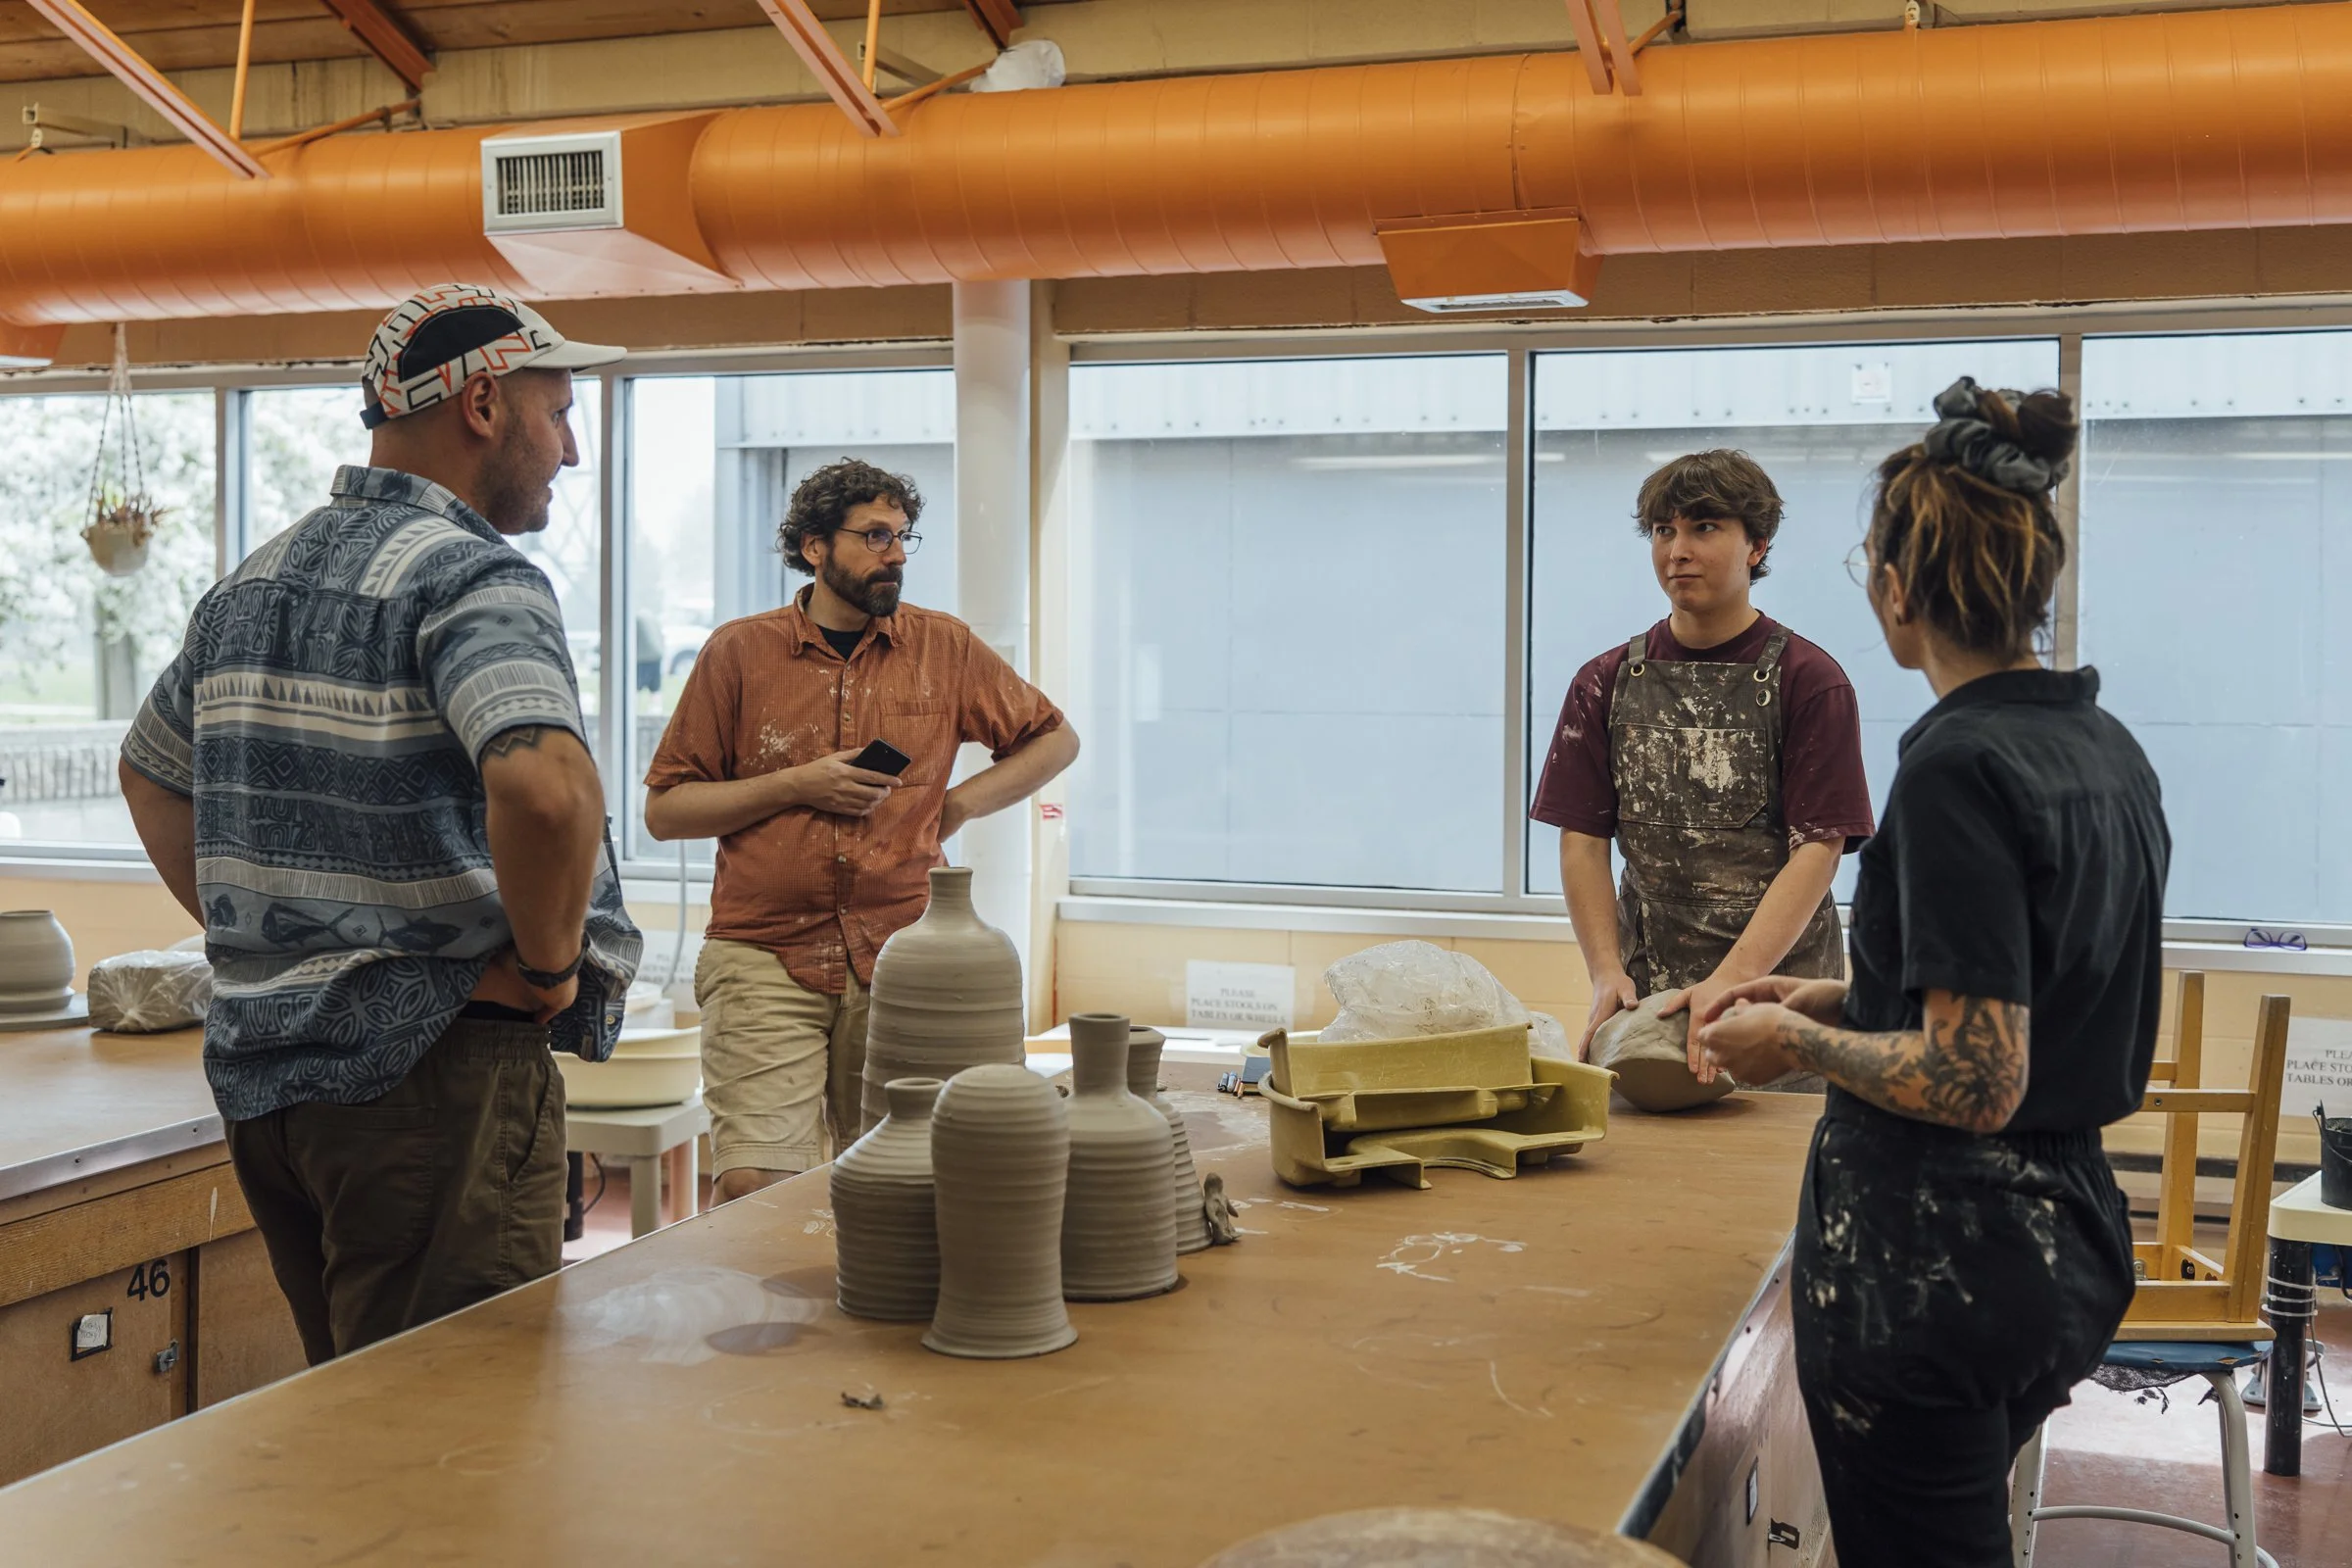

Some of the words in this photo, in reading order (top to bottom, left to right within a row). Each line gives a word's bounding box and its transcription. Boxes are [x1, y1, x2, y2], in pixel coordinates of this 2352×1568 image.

[2287, 1059, 2327, 1071] PLACE
[2287, 1073, 2333, 1085] TABLES
[126, 1259, 171, 1301] 46
